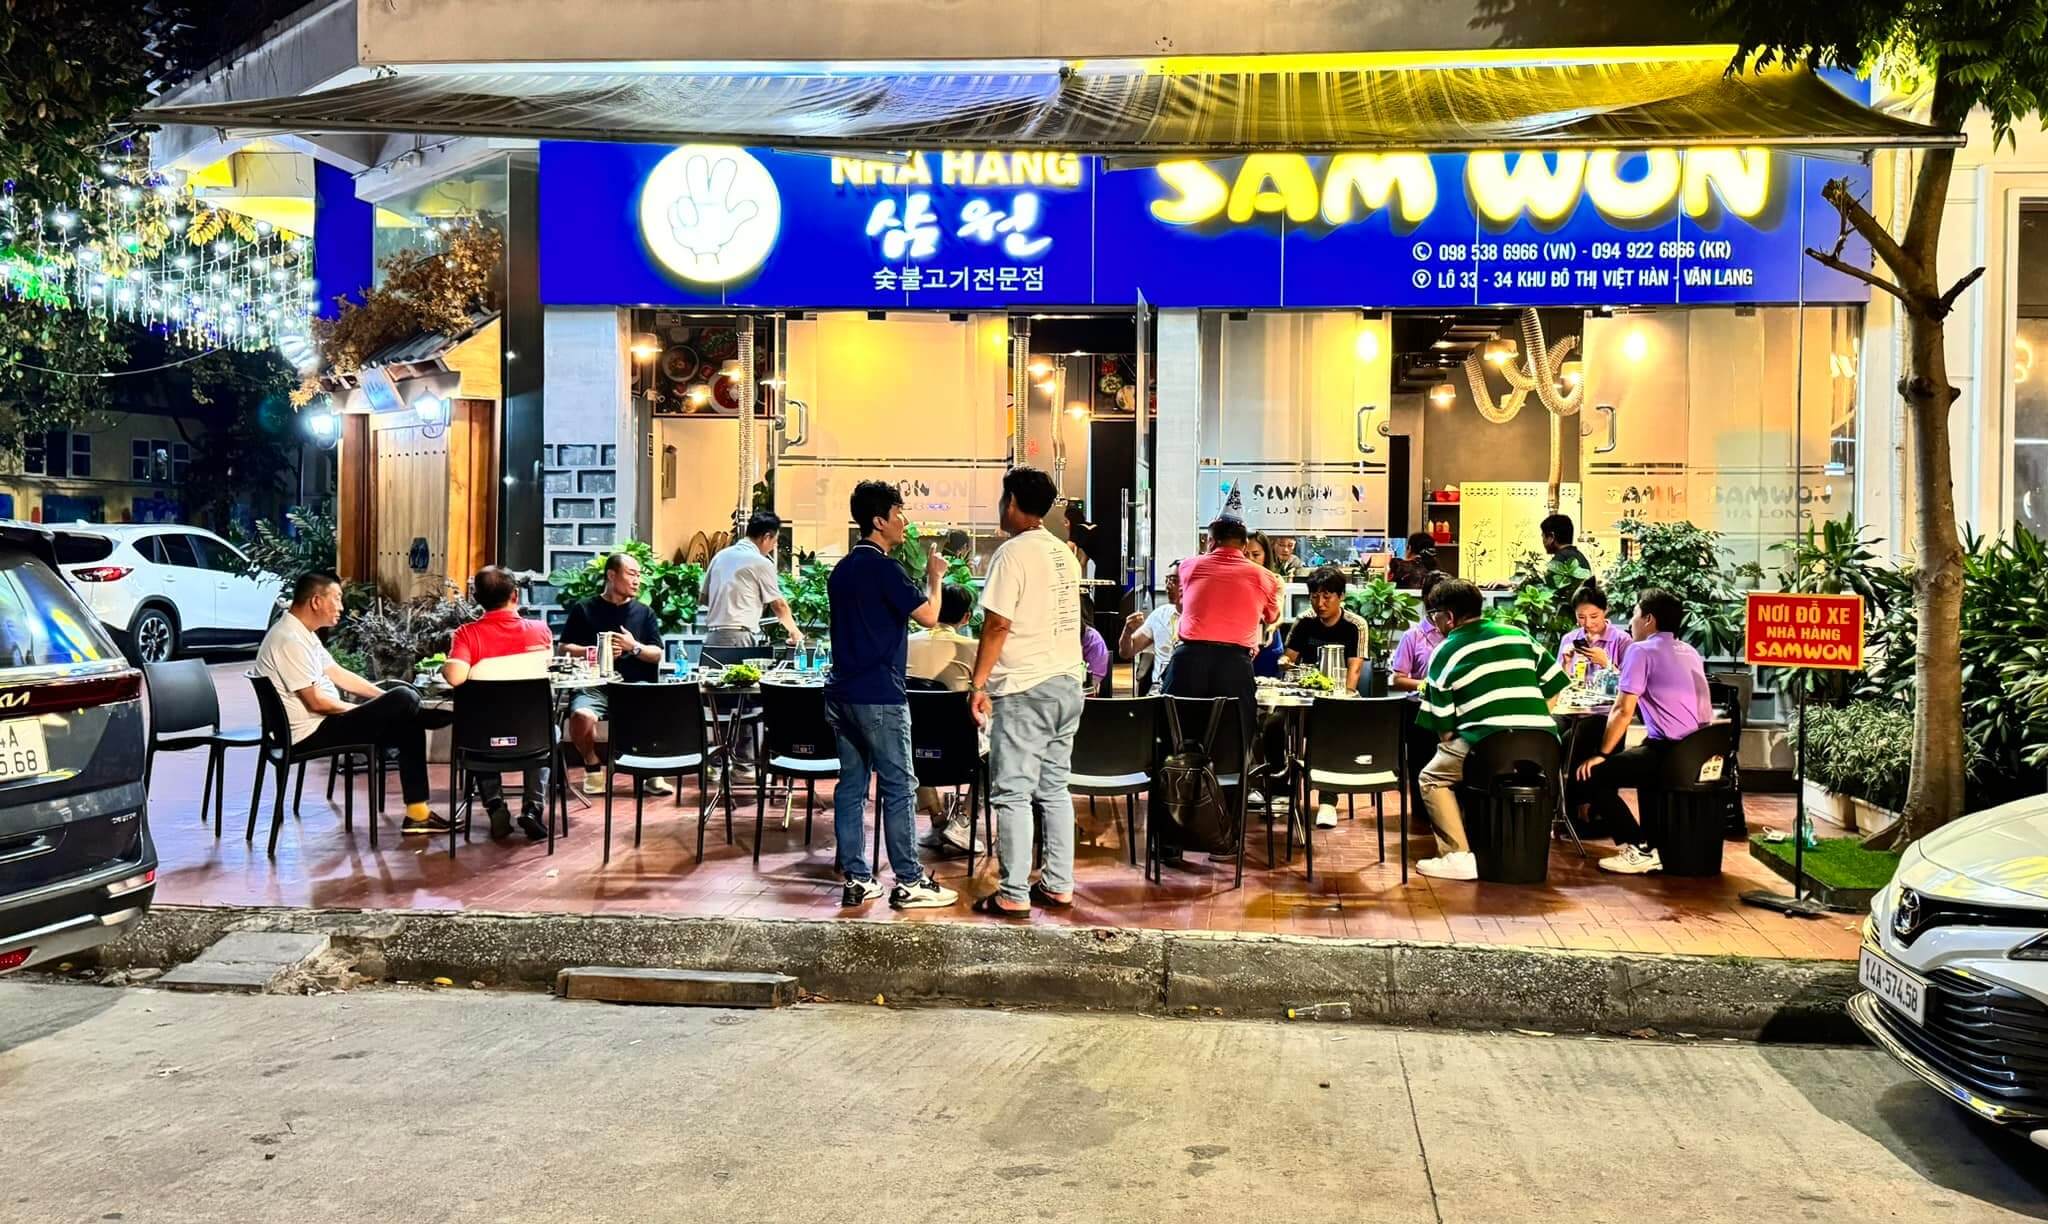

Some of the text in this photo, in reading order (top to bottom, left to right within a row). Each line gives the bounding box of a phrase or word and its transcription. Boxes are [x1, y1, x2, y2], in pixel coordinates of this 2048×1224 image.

[1150, 149, 1771, 224] SAM WON
[1439, 244, 1466, 261] 098
[1471, 243, 1498, 261] 538
[1503, 243, 1538, 260] 6966
[1543, 242, 1576, 261] (VN)
[1592, 242, 1621, 259] 094
[1626, 242, 1653, 259] 922
[1659, 241, 1695, 259] 6866
[1699, 240, 1731, 259] (KR)
[873, 266, 1044, 291] 숯불고기전문점
[1438, 269, 1455, 288] LÔ
[1460, 271, 1477, 288] 33
[1494, 271, 1512, 287] 34
[1517, 271, 1546, 287] KHU
[1574, 270, 1597, 289] THỊ
[1603, 267, 1634, 289] VIỆT
[1638, 266, 1668, 287] HÀN
[1715, 268, 1753, 286] LANG
[1757, 600, 1850, 625] NƠI ĐỖ XE
[1766, 624, 1841, 641] NHÀ HÀNG
[1754, 641, 1853, 661] SAMWON
